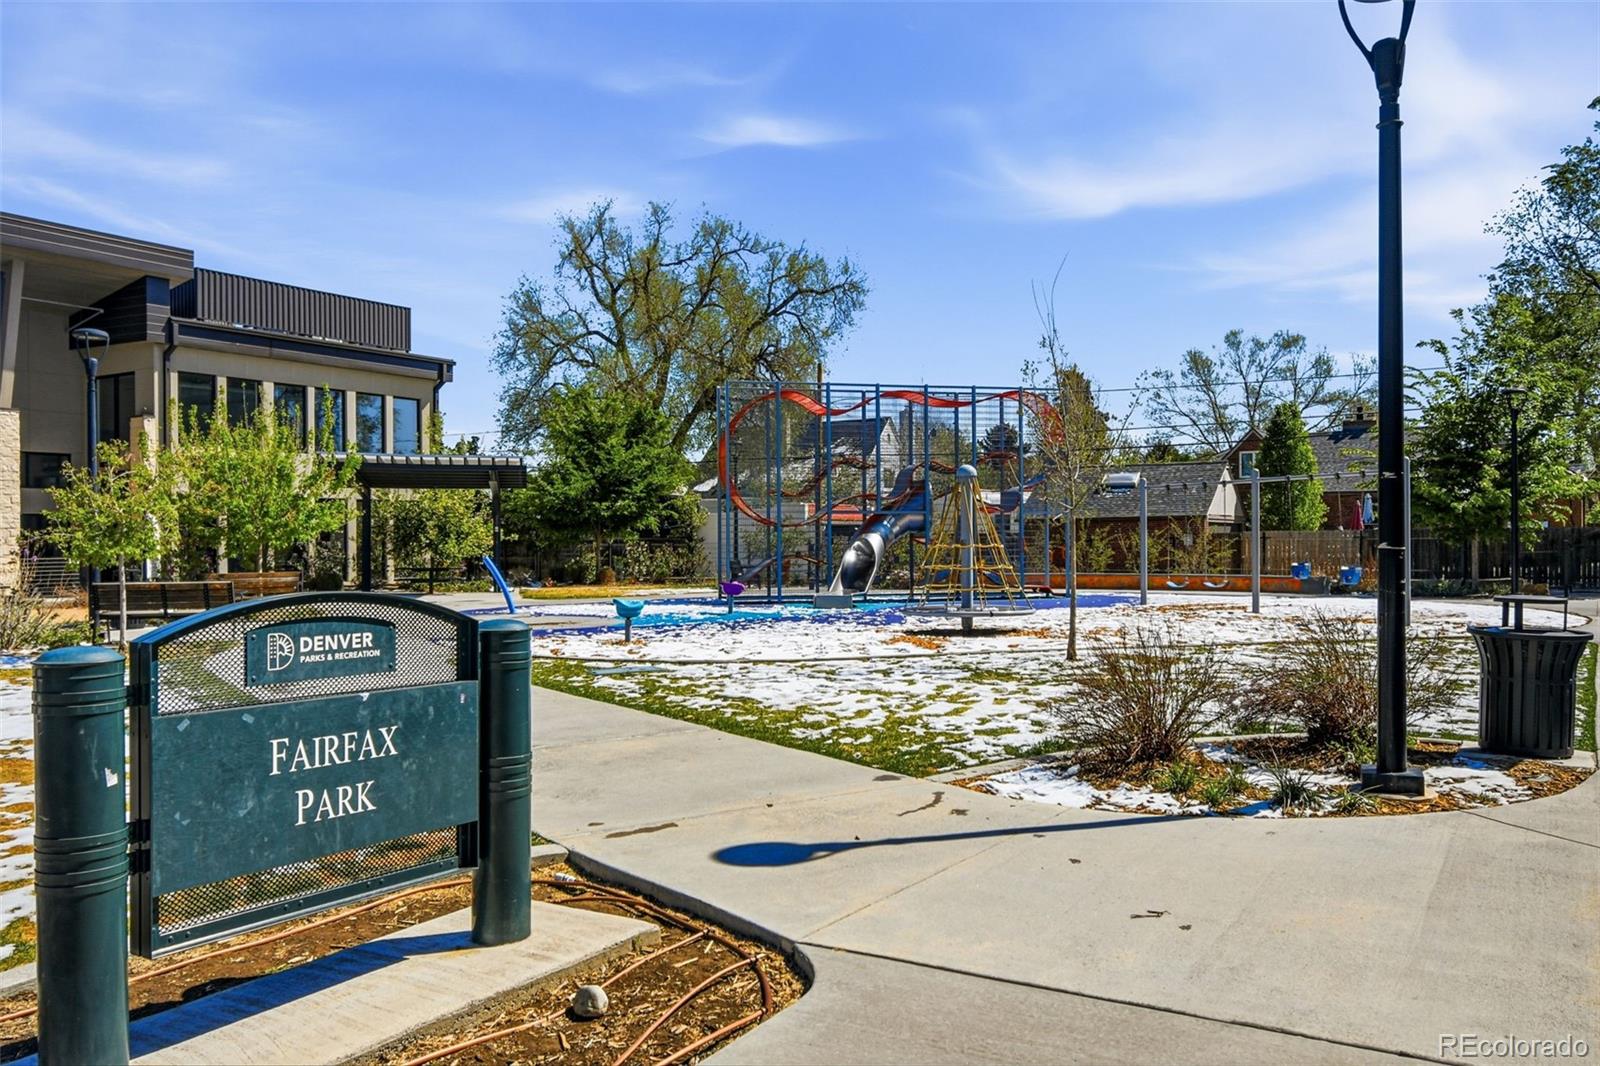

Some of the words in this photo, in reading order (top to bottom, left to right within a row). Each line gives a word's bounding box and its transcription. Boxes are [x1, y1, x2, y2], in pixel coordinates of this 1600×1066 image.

[300, 632, 373, 653] DENVER
[300, 653, 325, 663] PARKS
[334, 650, 380, 661] RECREATION
[269, 725, 399, 776] FAIRFAX
[294, 780, 377, 826] PARK
